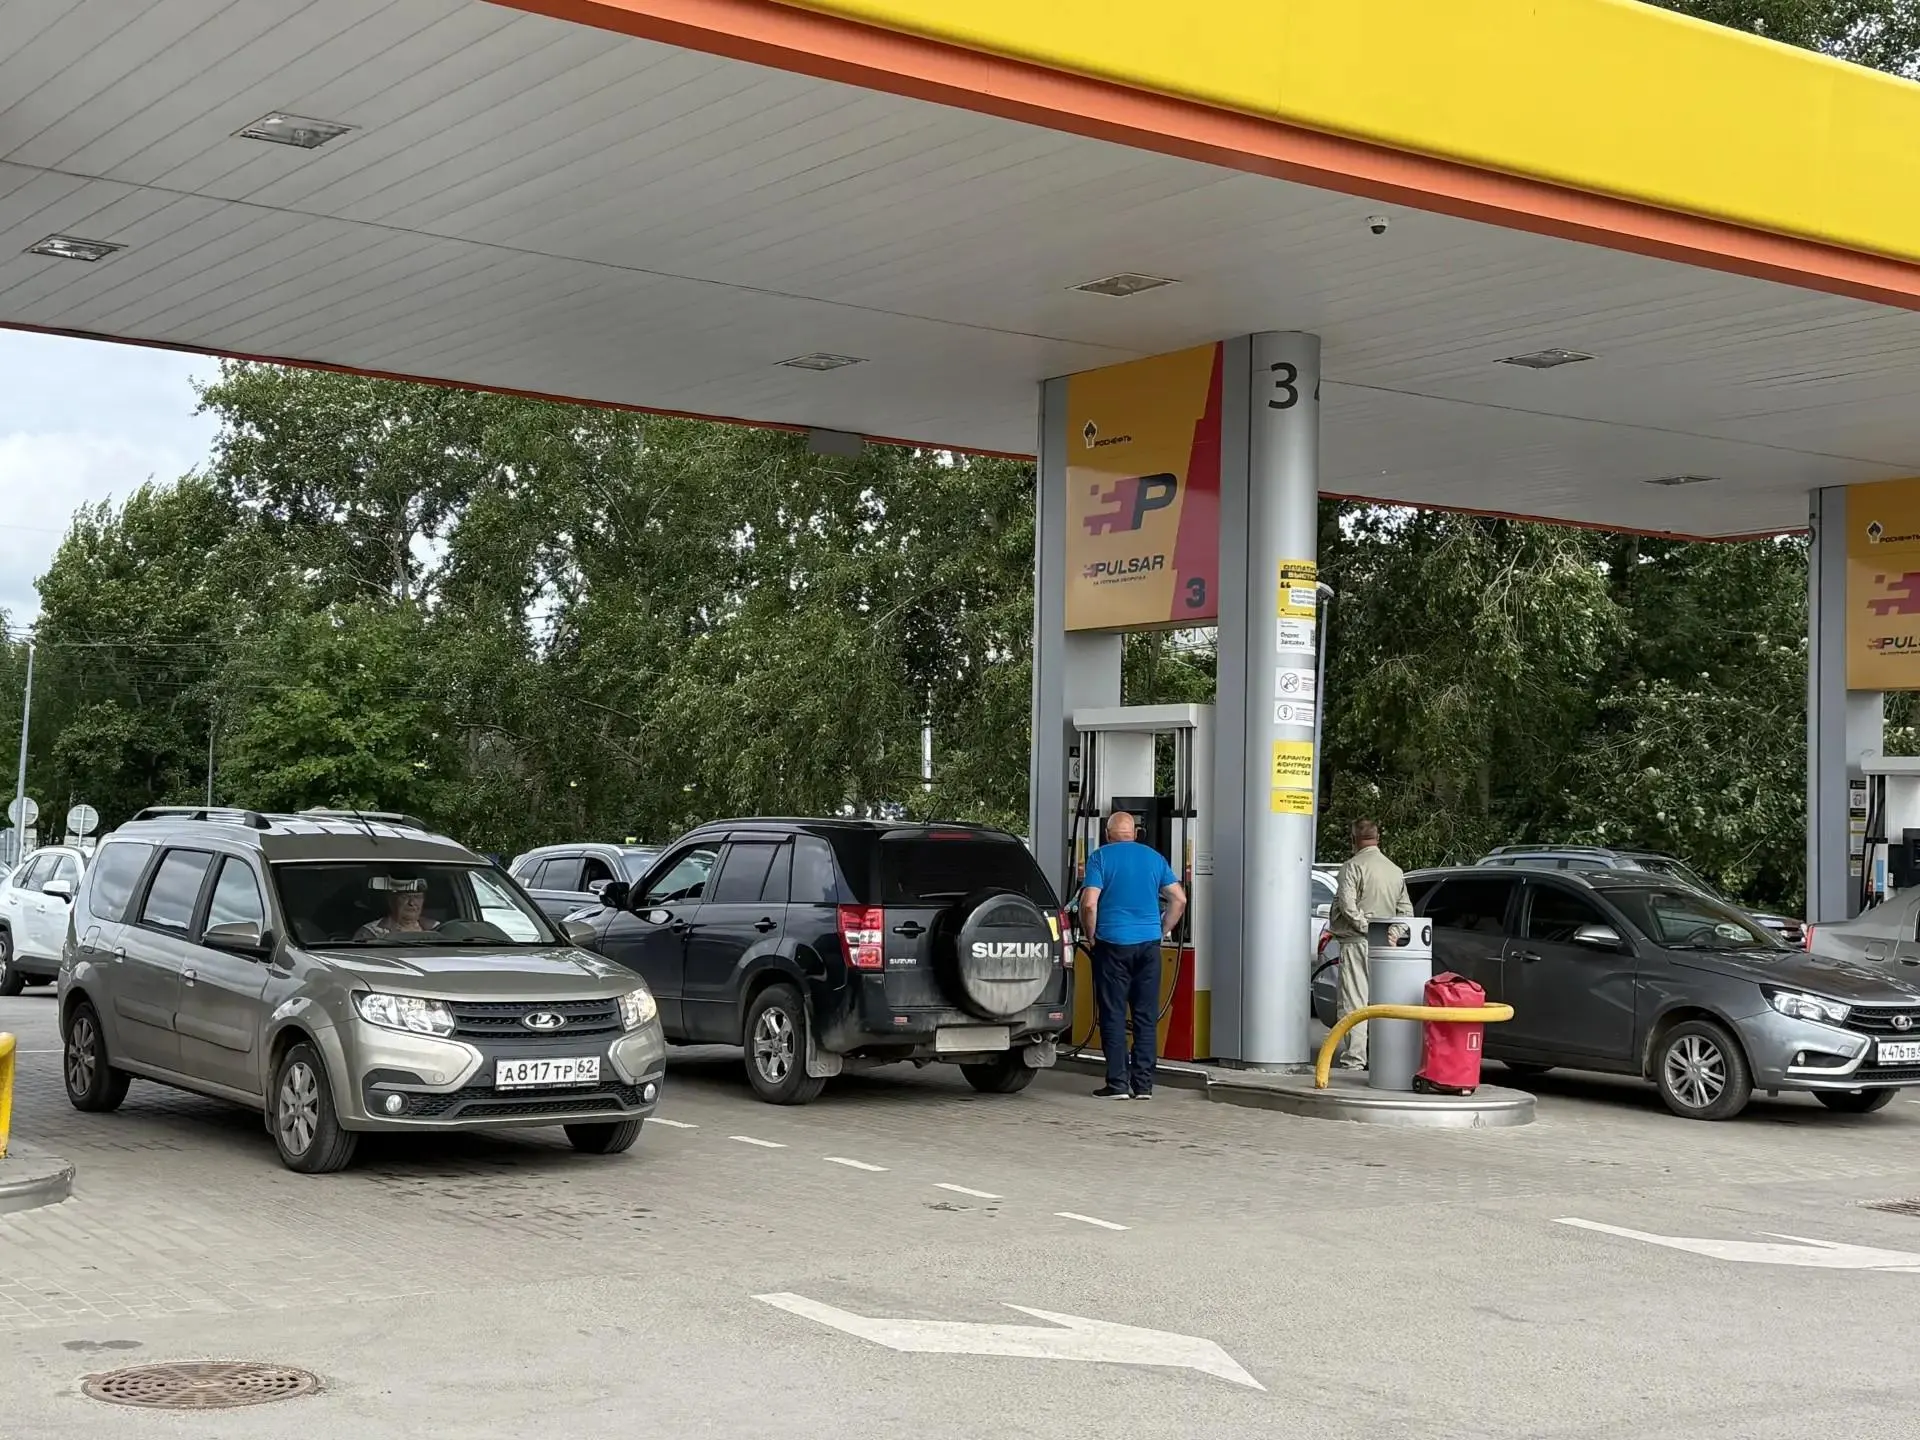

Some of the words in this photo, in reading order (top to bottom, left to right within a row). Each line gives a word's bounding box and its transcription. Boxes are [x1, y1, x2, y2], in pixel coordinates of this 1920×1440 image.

[1269, 362, 1299, 410] 3
[1094, 554, 1165, 577] PULSAR
[1185, 577, 1206, 609] 3
[1880, 635, 1920, 649] PUL
[971, 942, 1049, 959] SUZUKI
[577, 1060, 594, 1073] 62
